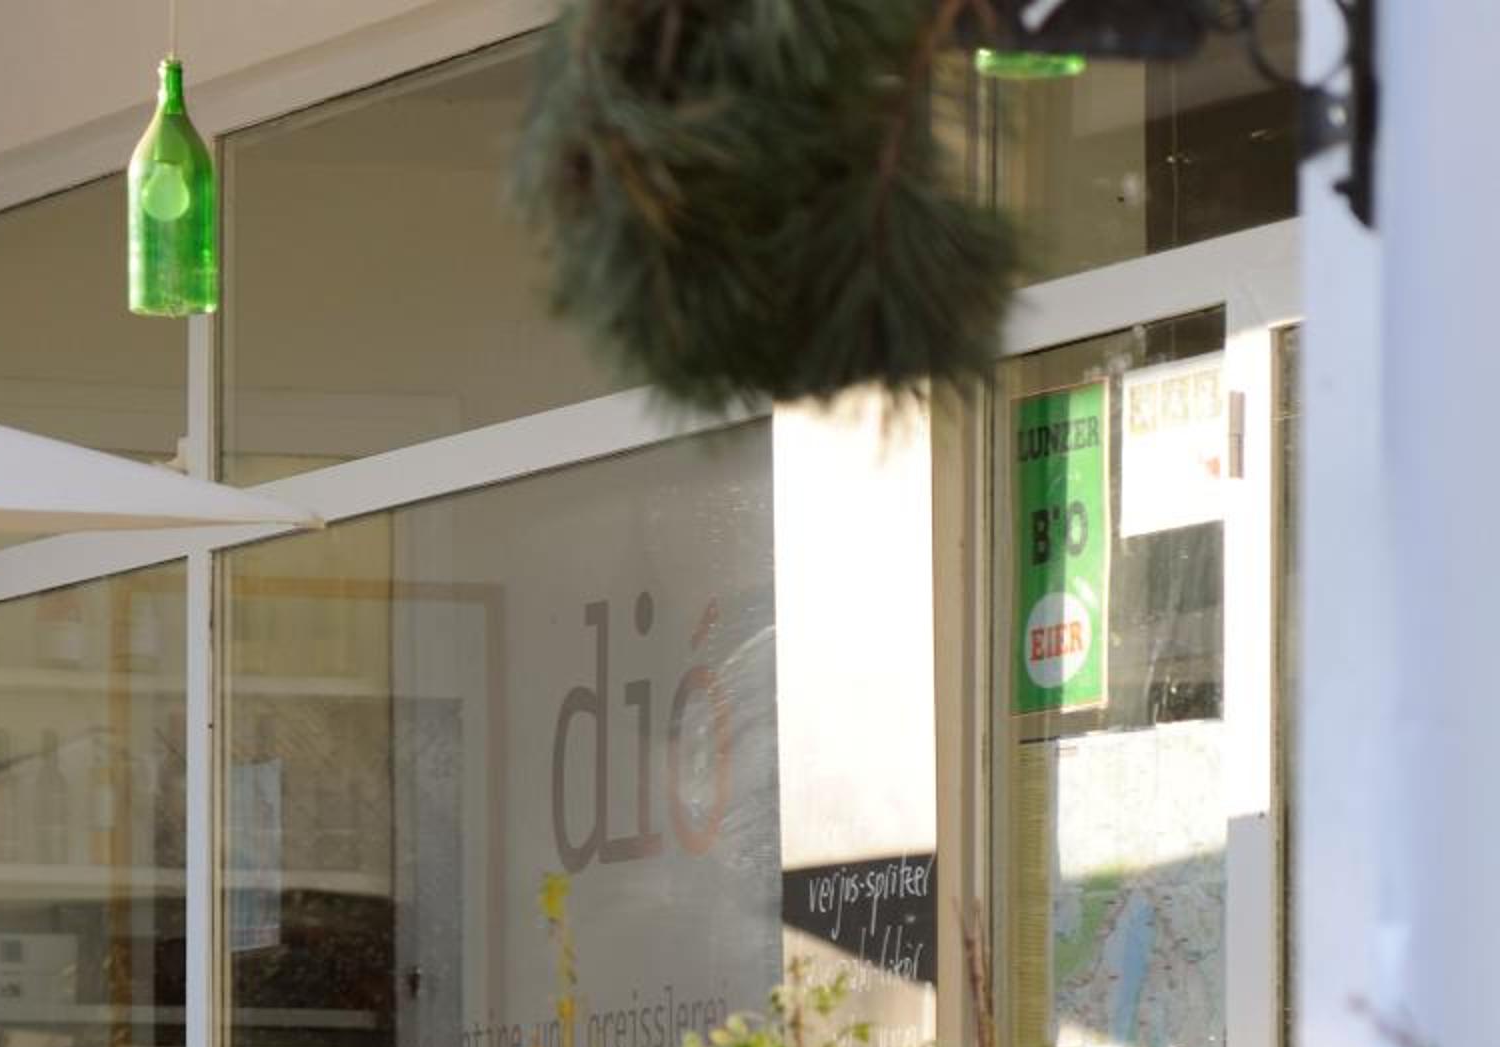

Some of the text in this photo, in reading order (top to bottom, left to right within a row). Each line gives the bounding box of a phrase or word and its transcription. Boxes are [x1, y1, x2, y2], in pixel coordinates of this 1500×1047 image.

[1017, 416, 1099, 462] LUNZER
[1030, 622, 1084, 661] EIER
[552, 591, 731, 874] dió
